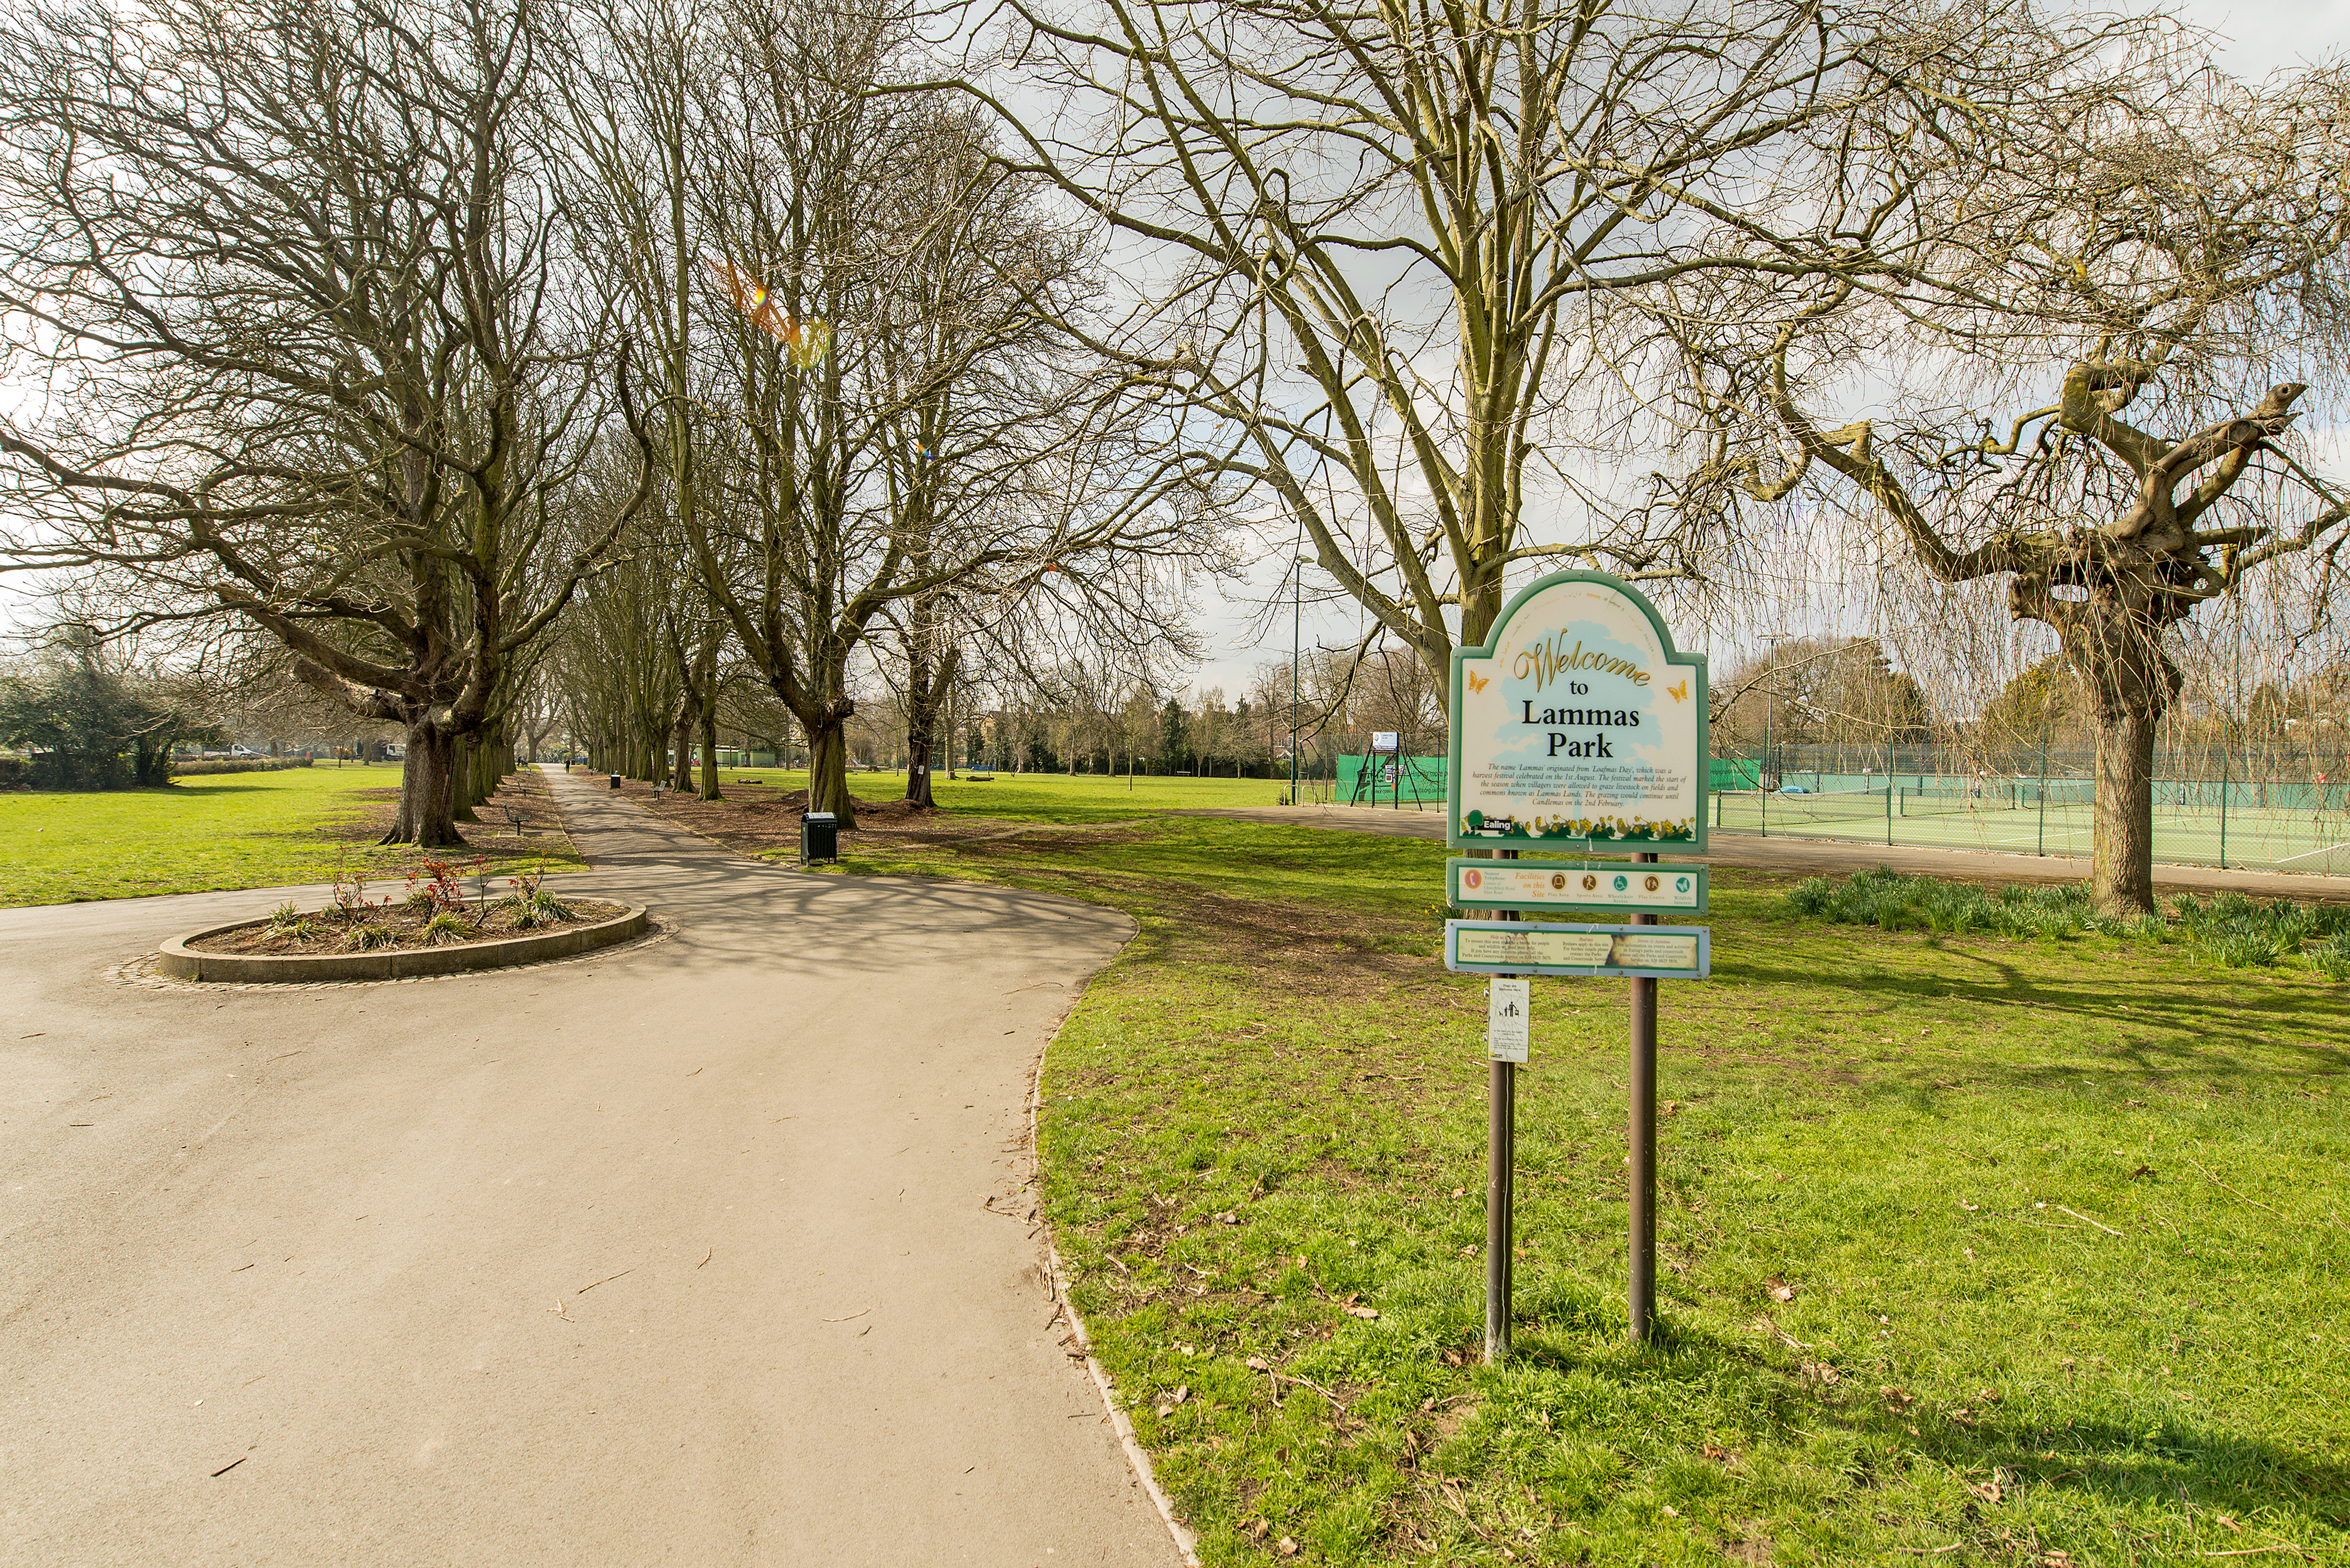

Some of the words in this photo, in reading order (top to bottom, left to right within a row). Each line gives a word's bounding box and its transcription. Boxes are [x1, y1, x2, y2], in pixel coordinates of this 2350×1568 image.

[1514, 628, 1650, 693] Welcome
[1570, 681, 1588, 695] to
[1522, 700, 1640, 727] Lammas
[1547, 733, 1613, 758] Park
[1484, 821, 1511, 831] Ealing
